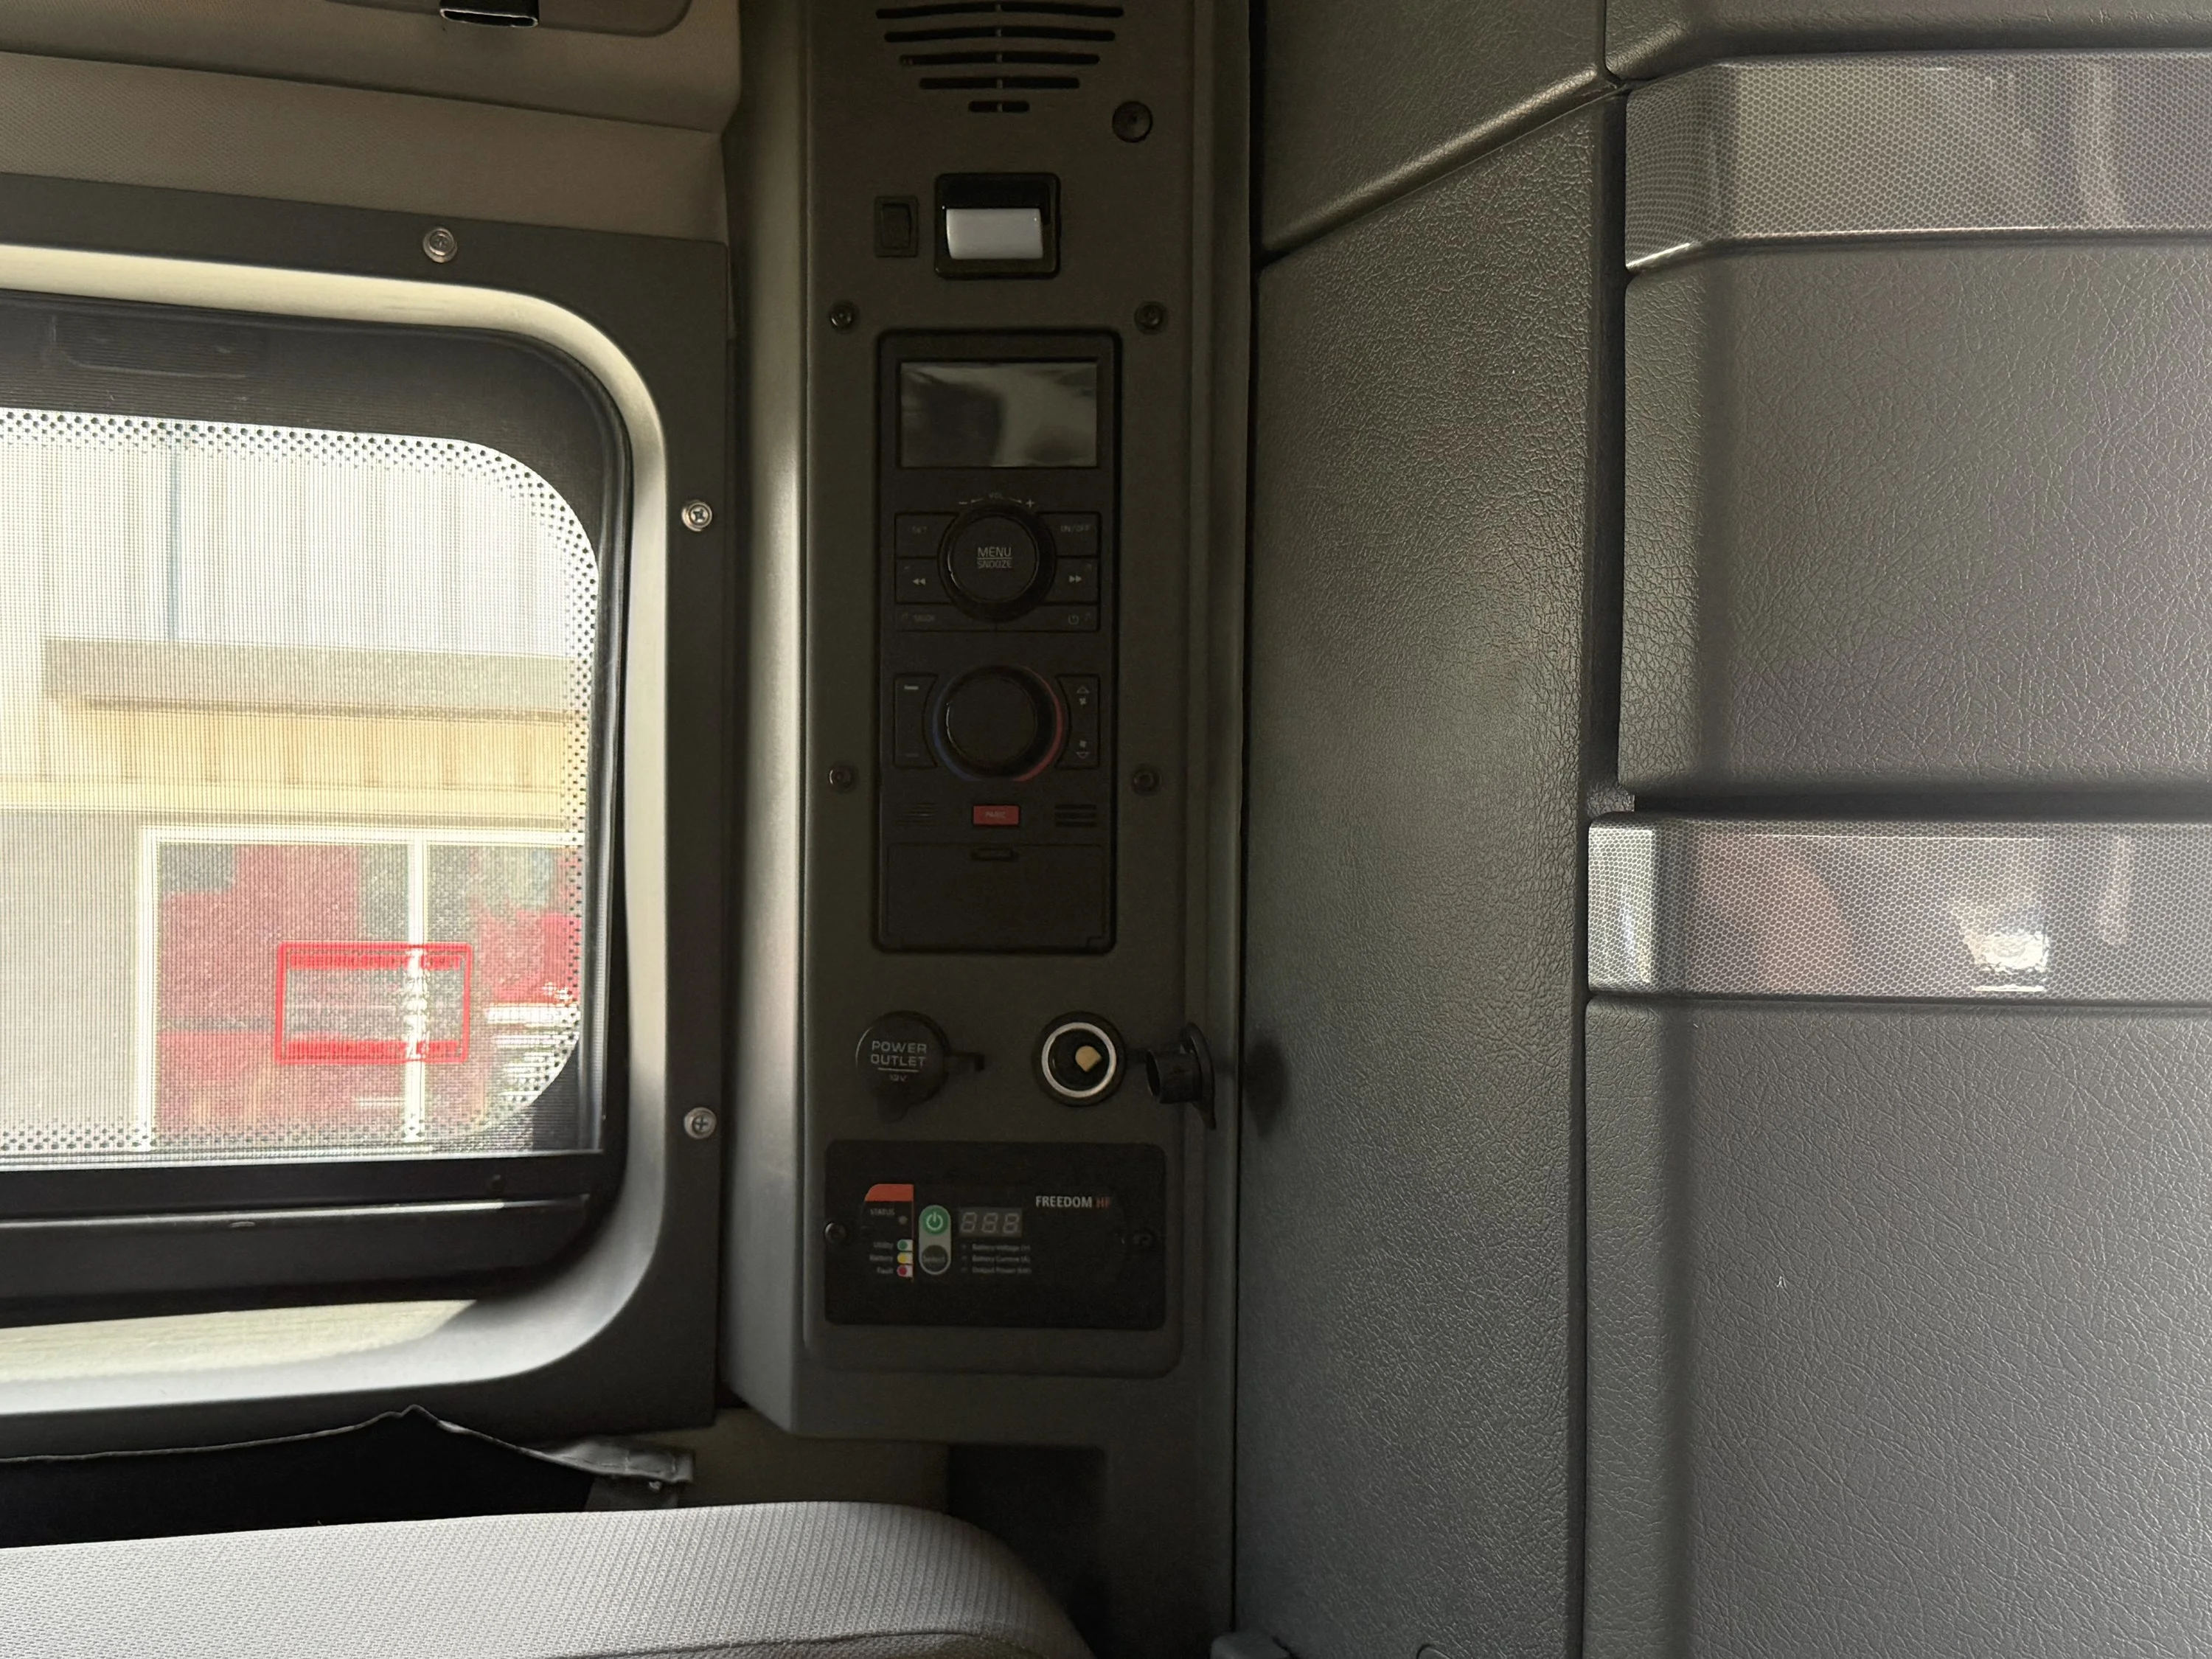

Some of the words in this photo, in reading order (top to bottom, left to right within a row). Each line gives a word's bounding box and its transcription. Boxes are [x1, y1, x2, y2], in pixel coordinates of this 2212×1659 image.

[977, 546, 1012, 557] MENU
[976, 560, 1013, 569] SNOOZE
[872, 1040, 927, 1054] POWER
[870, 1054, 926, 1068] OUTLET
[1035, 1195, 1093, 1208] FREEDOM
[870, 1208, 895, 1216] STATUS
